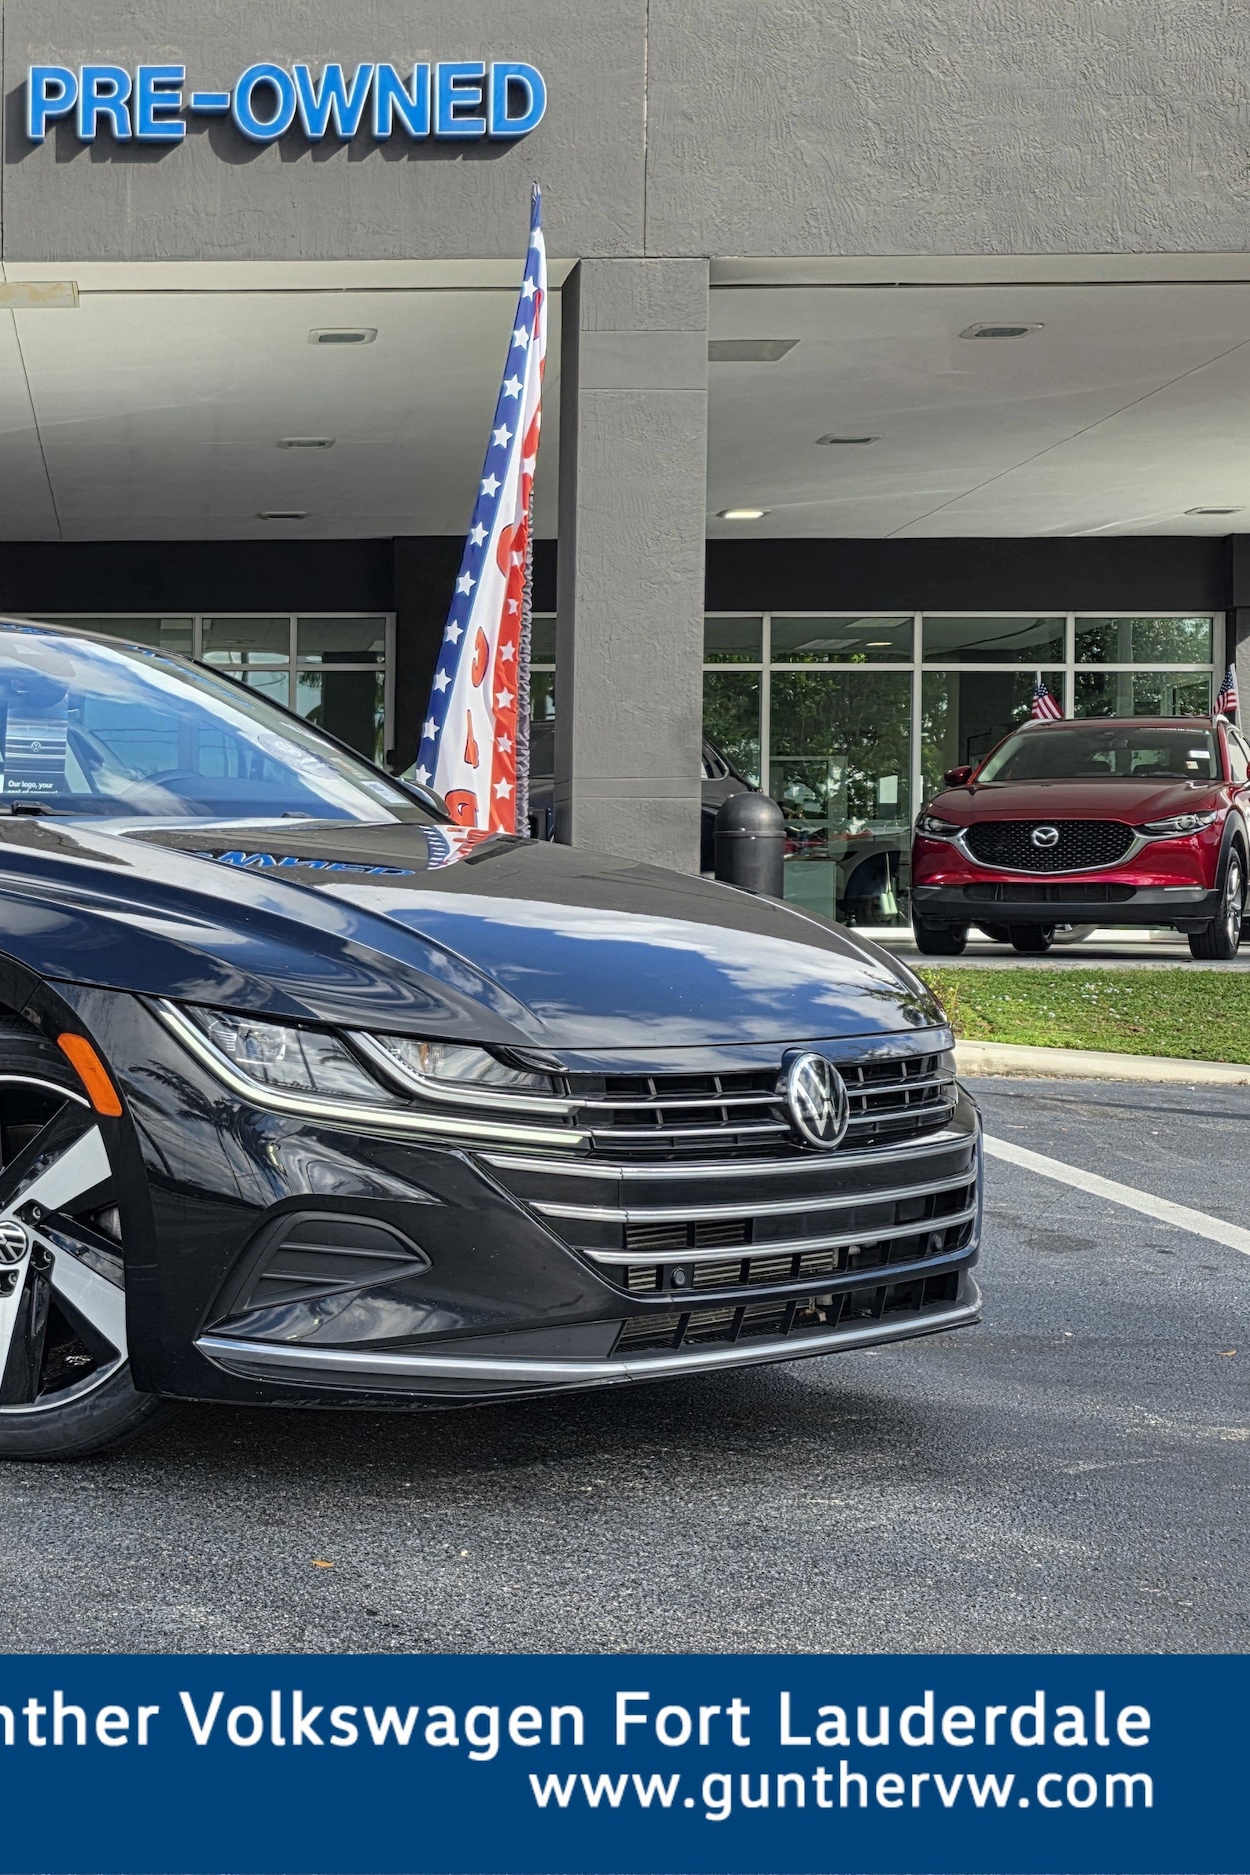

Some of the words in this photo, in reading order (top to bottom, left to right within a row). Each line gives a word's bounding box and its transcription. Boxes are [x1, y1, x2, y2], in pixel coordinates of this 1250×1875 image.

[27, 62, 548, 142] PRE-OWNED
[8, 780, 21, 788] Our
[21, 780, 38, 789] logo,
[38, 782, 54, 790] your
